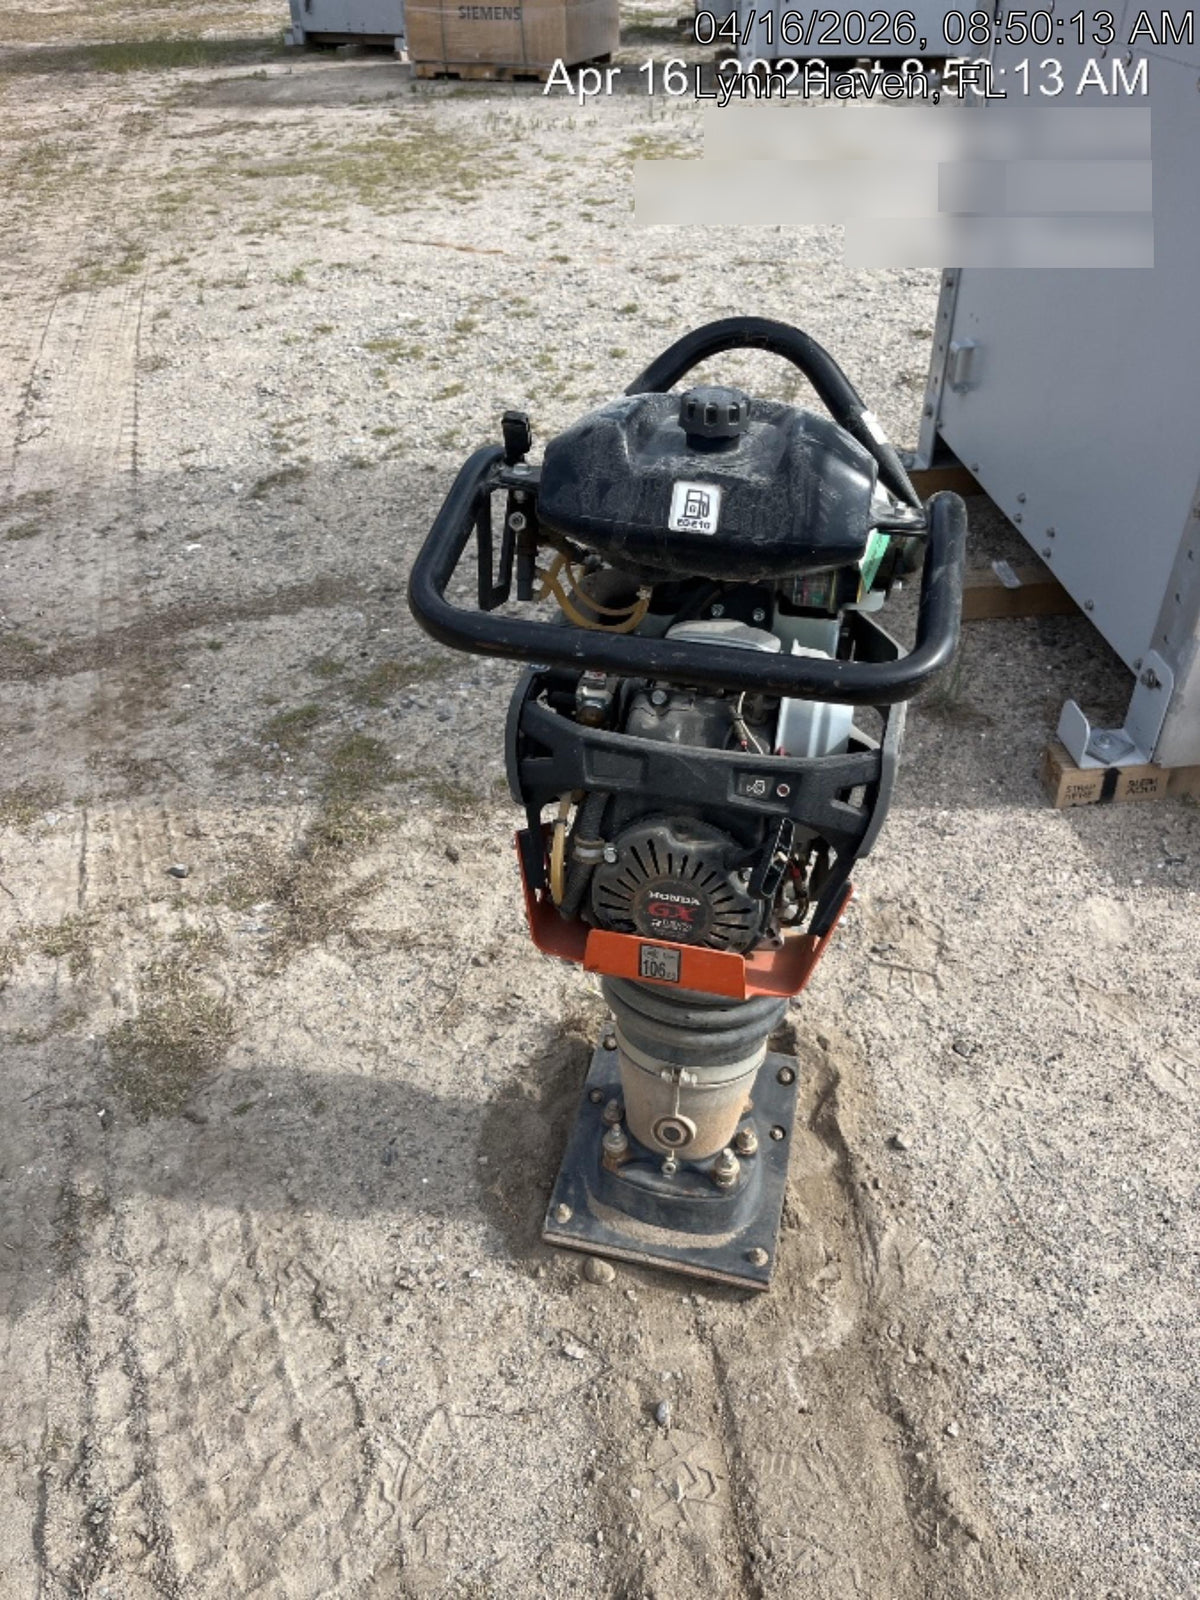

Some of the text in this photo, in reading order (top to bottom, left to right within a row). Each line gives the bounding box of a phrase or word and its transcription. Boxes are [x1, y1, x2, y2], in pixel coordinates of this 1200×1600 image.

[458, 5, 521, 20] SIEMENS
[648, 890, 700, 906] HONDA
[648, 901, 698, 922] GX
[643, 959, 666, 977] 106
